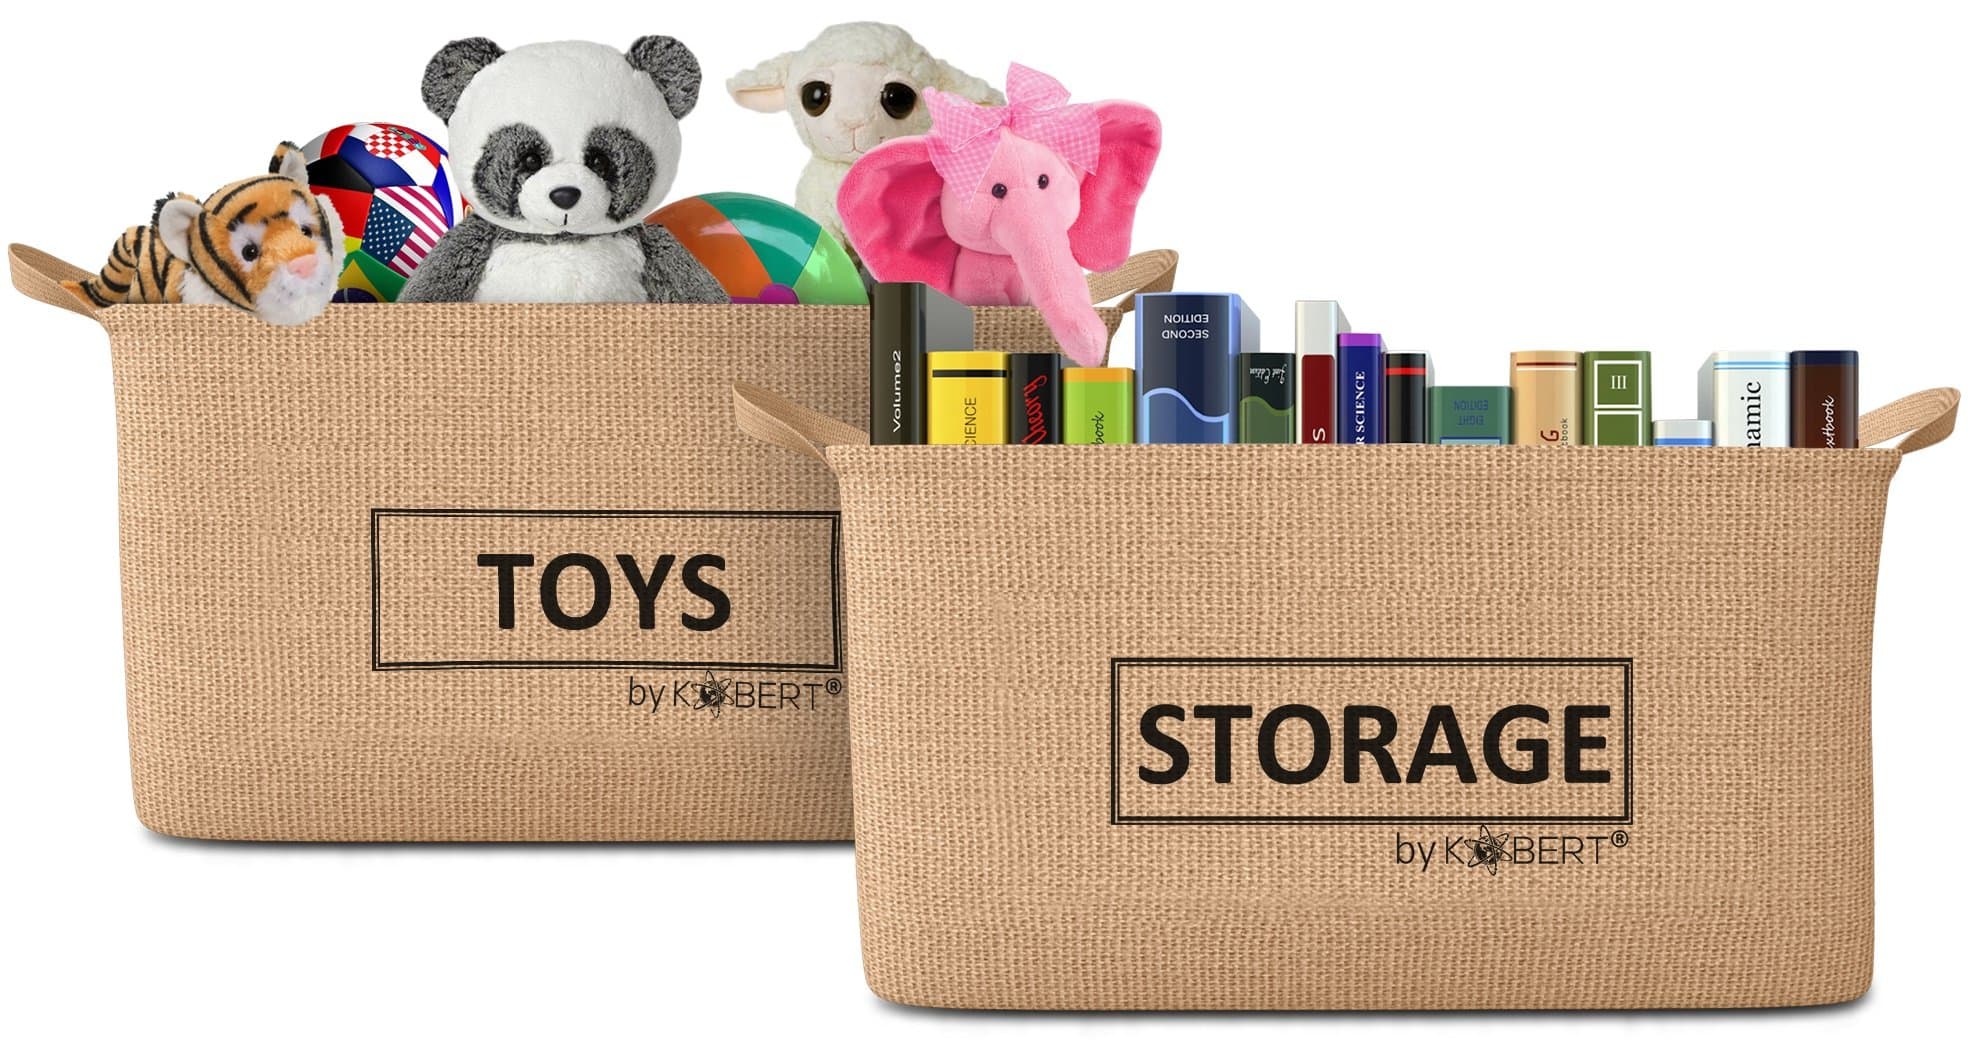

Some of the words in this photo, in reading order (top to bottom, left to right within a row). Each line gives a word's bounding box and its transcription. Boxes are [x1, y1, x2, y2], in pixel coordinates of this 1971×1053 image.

[1162, 329, 1210, 340] SECOND
[1163, 314, 1210, 324] EDITION
[892, 350, 902, 433] Volume2
[1355, 371, 1366, 433] SCIENCE
[1453, 400, 1489, 411] EDITION
[1312, 427, 1326, 441] S
[1457, 415, 1484, 426] EIGHT
[1821, 395, 1836, 448] xtbook
[477, 552, 732, 632] TOYS
[628, 675, 666, 713] by
[1138, 703, 1611, 785] STORAGE
[1396, 831, 1436, 872] by
